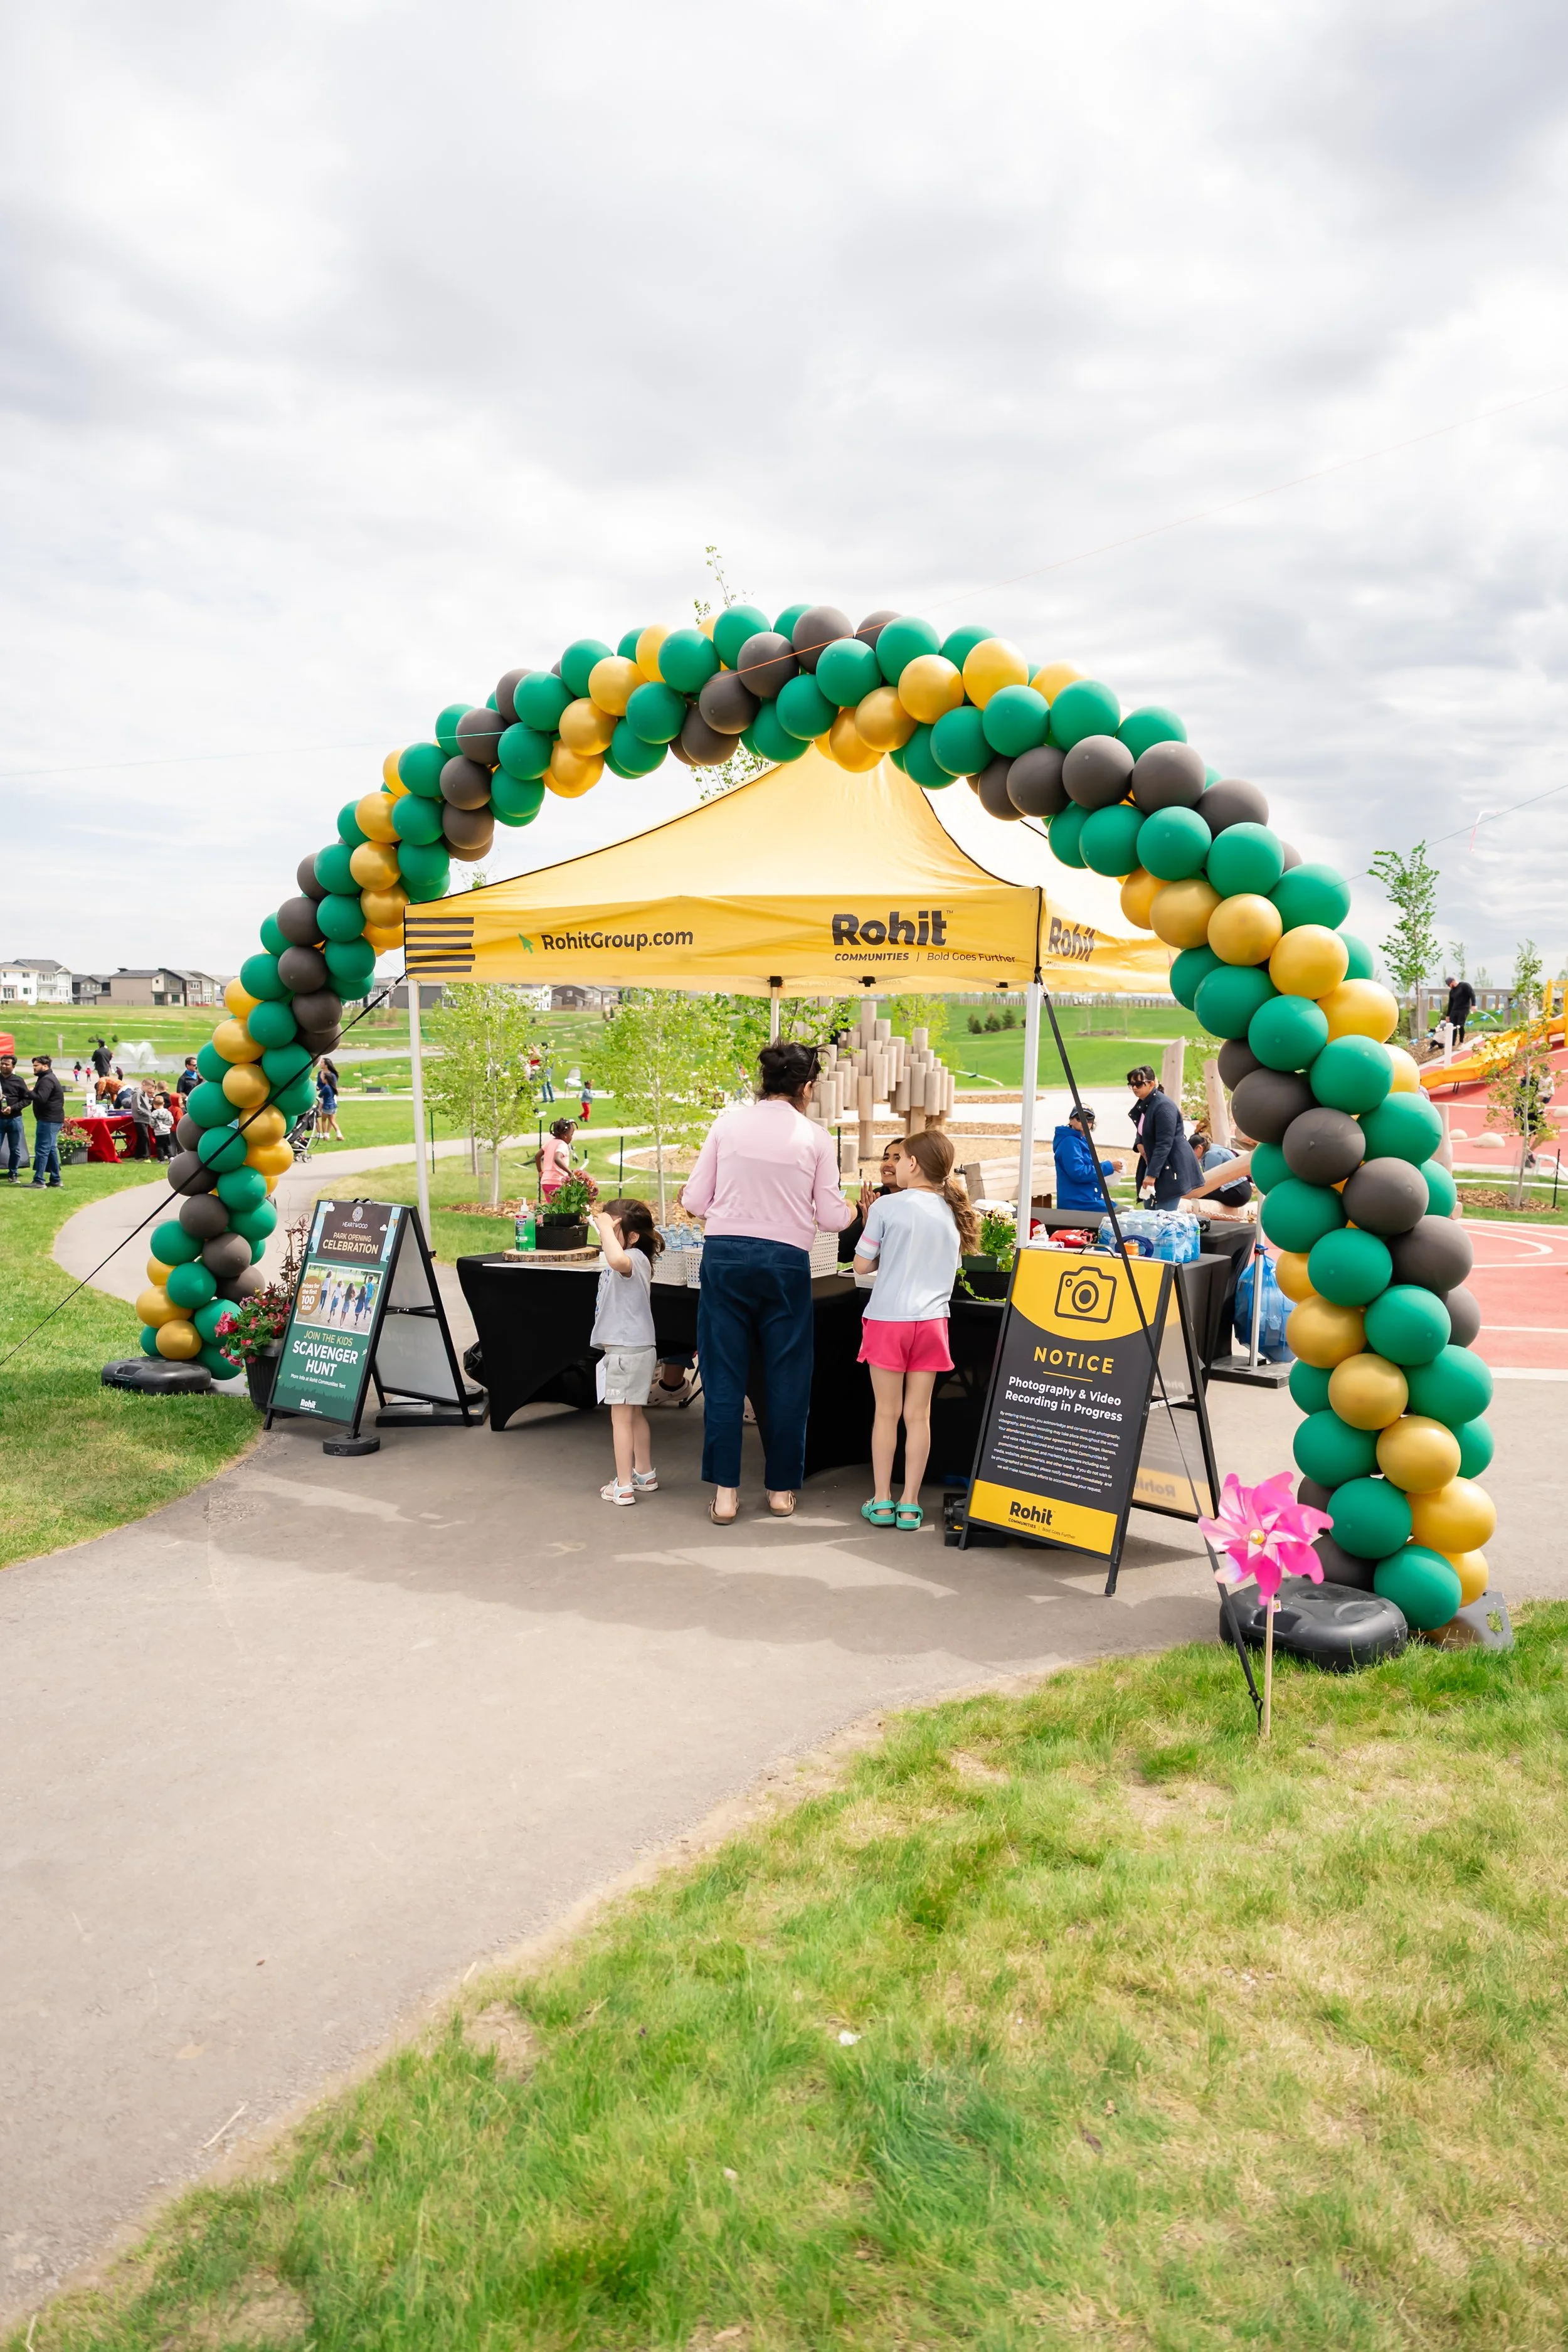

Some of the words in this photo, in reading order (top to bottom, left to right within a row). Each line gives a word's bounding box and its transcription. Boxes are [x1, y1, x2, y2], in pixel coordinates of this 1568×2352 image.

[832, 910, 947, 946] Rohit
[541, 930, 694, 951] RohitGroup.com
[1048, 916, 1096, 962] Rohit
[834, 952, 909, 961] COMMUNITIES
[927, 951, 949, 961] Bold
[951, 952, 977, 961] Goes
[978, 953, 1016, 963] Further
[322, 1239, 379, 1254] CELEBRATION
[347, 1234, 372, 1242] OPENING
[301, 1295, 315, 1305] 100
[304, 1330, 321, 1341] JOIN
[322, 1333, 336, 1343] THE
[336, 1335, 353, 1347] KIDS
[292, 1340, 359, 1365] SCAVENGER
[1034, 1346, 1115, 1374] NOTICE
[305, 1359, 337, 1377] HUNT
[318, 1379, 339, 1387] Communities
[1009, 1375, 1077, 1399] Photography
[1078, 1389, 1086, 1399] &
[1089, 1391, 1121, 1406] Video
[300, 1399, 316, 1409] Rohit
[1005, 1390, 1058, 1411] Recording
[1061, 1400, 1071, 1411] in
[1074, 1403, 1123, 1422] Progress
[1009, 1501, 1053, 1525] Rohit
[1008, 1518, 1036, 1528] COMMUNITIES
